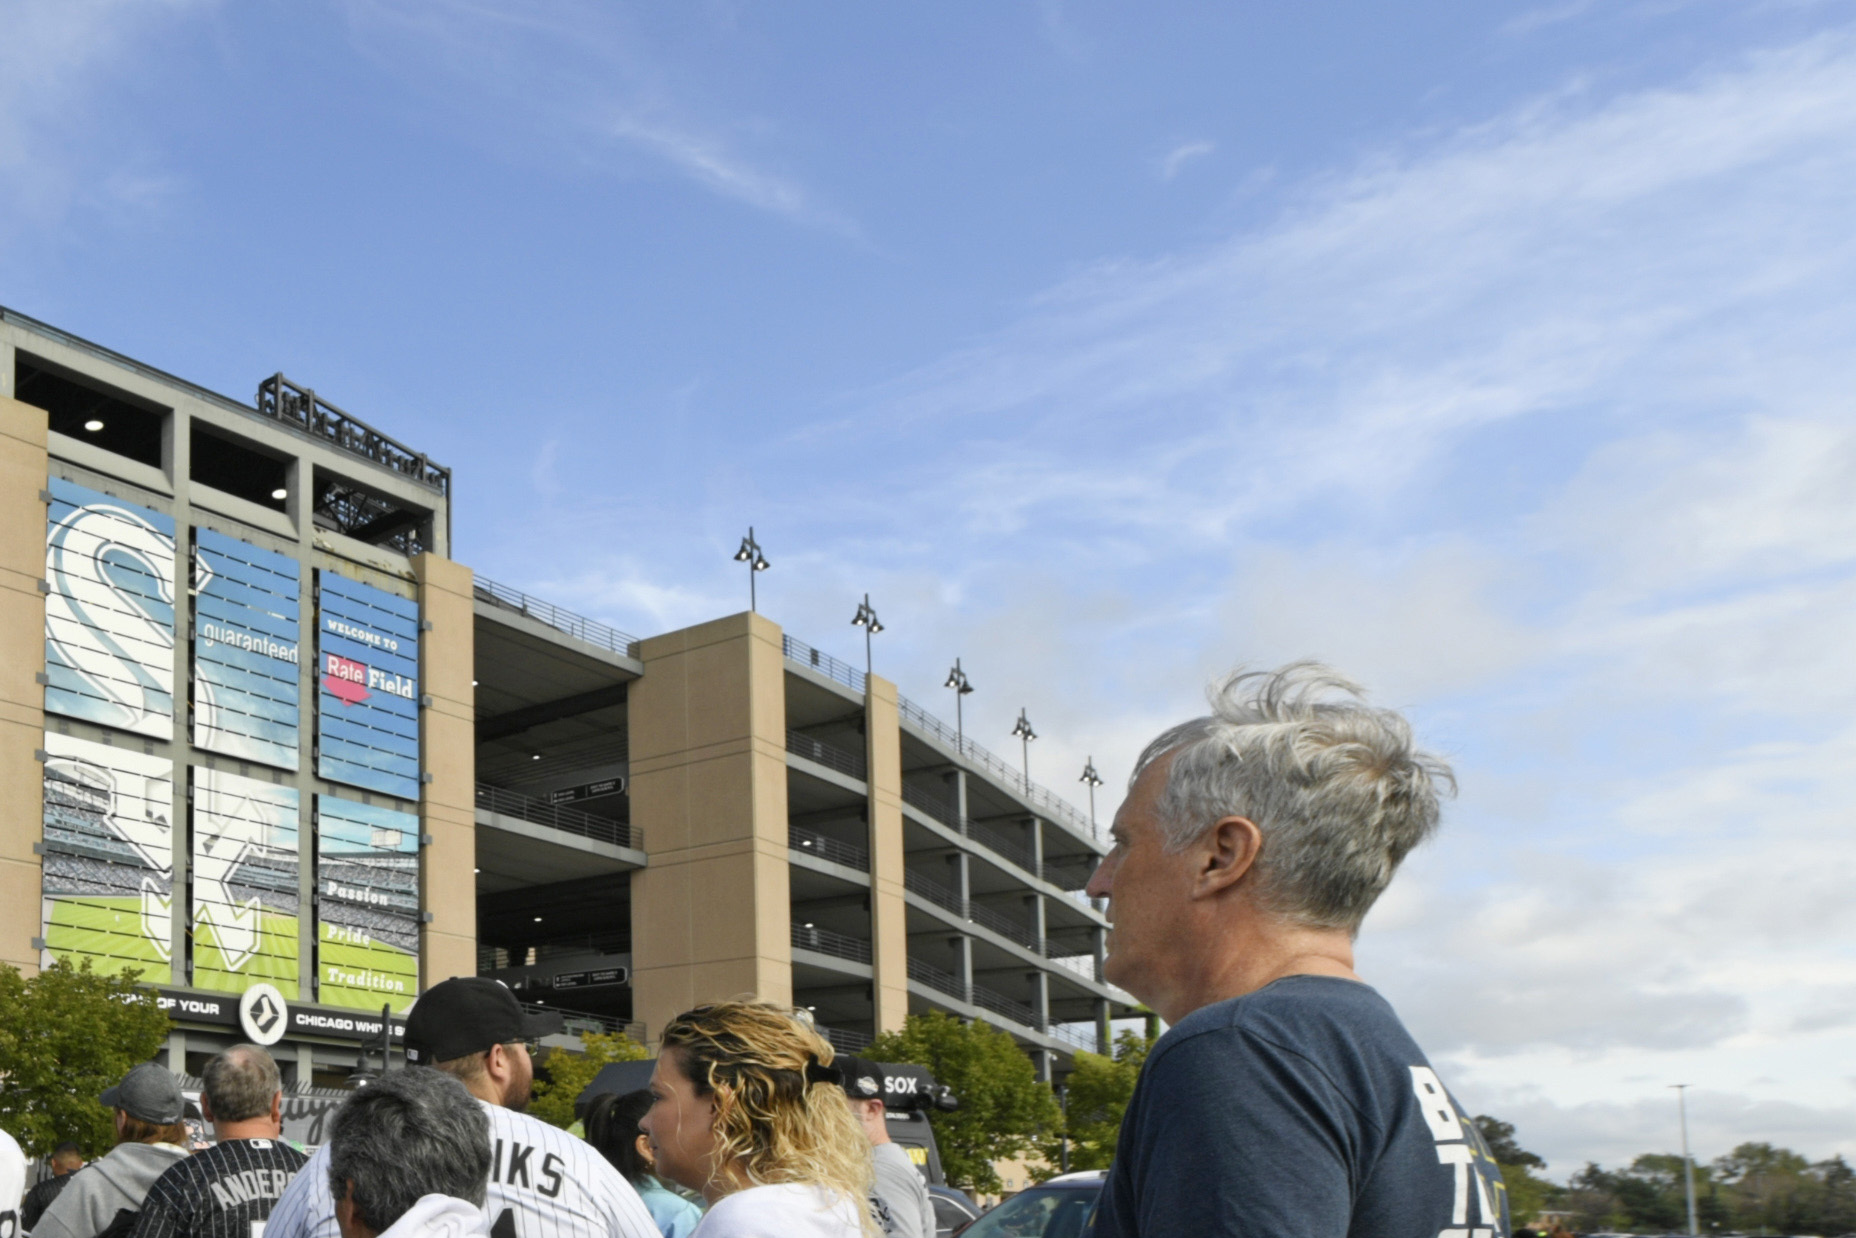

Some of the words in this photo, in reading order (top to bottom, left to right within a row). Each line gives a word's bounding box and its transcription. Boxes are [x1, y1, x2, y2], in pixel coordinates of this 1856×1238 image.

[204, 623, 298, 663] guaranteed
[327, 619, 381, 644] WELCOME
[383, 637, 398, 650] TO
[327, 656, 363, 683] Rate
[368, 668, 413, 698] Field
[327, 881, 388, 906] Passion
[327, 925, 370, 945] Pride
[327, 968, 404, 992] Tradition
[179, 1000, 219, 1014] YOUR
[296, 1014, 353, 1030] CHICAGO
[884, 1076, 918, 1094] SOX
